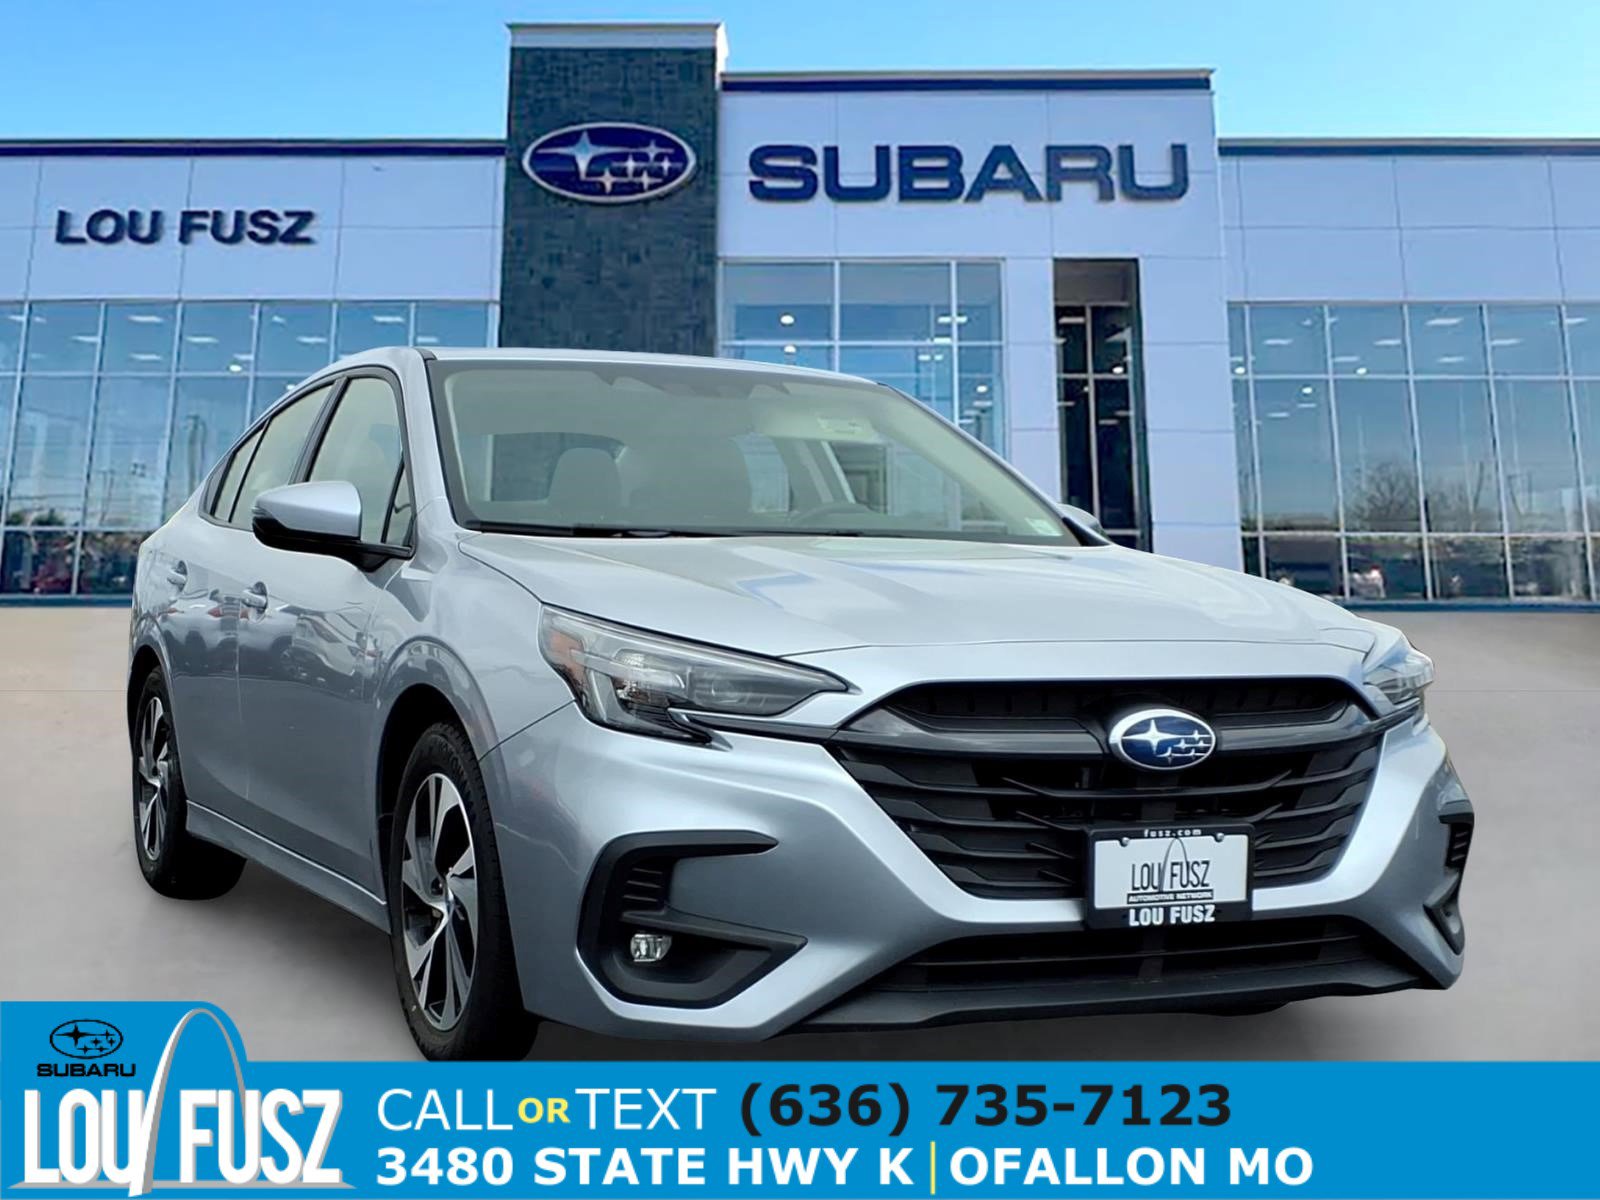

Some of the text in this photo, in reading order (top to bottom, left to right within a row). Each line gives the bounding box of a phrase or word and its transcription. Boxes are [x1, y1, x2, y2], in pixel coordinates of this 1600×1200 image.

[748, 144, 1189, 201] SUBARU
[55, 209, 316, 245] LOU FUSZ
[1143, 829, 1202, 838] fusz.com
[1131, 860, 1211, 891] LOU FUSZ
[1129, 904, 1216, 927] LOU FUSZ
